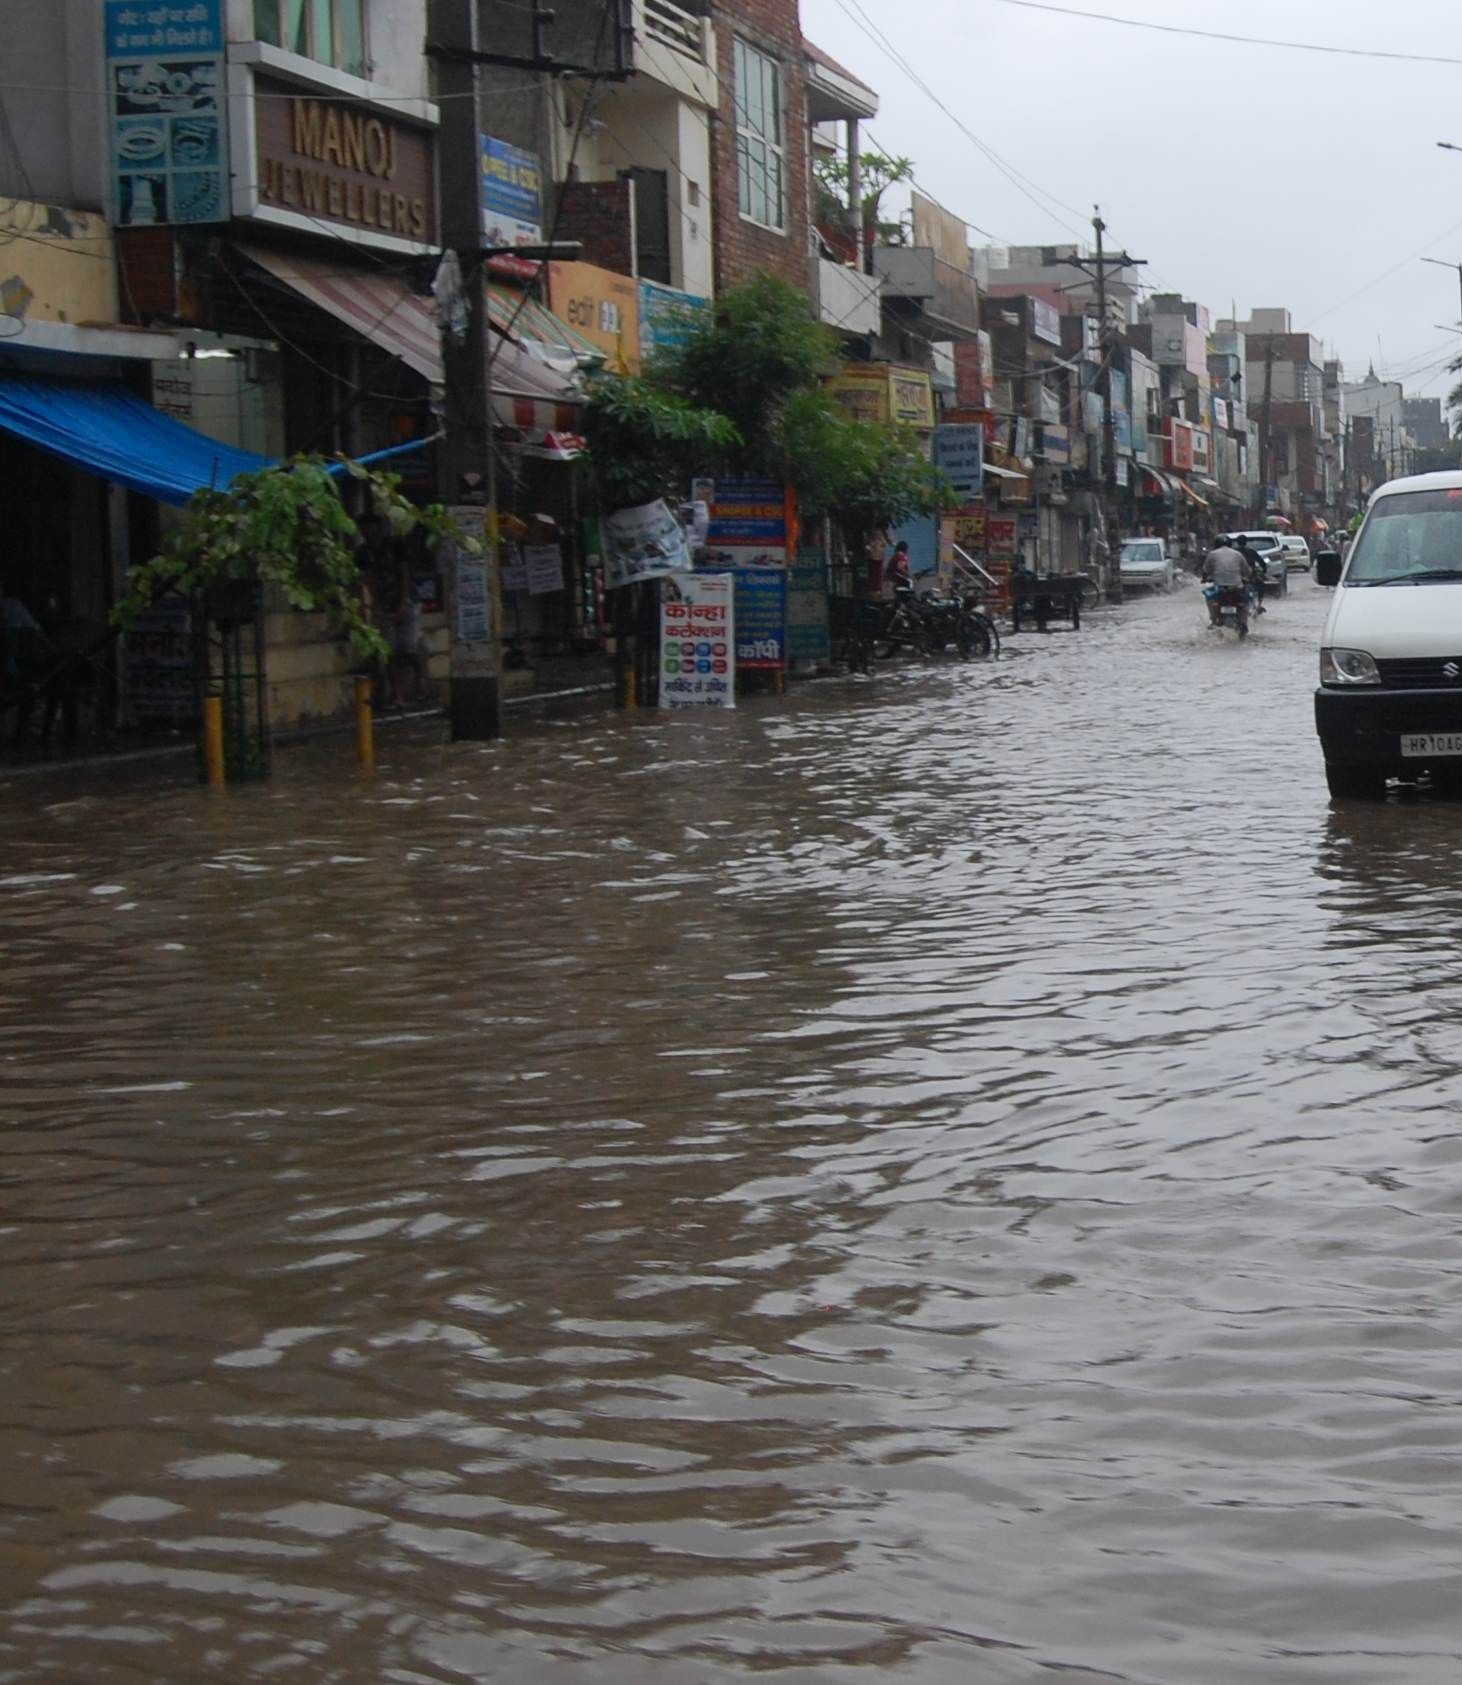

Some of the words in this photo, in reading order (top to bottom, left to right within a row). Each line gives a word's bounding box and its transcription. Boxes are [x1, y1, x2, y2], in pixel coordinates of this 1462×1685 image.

[294, 97, 396, 181] MANOJ
[263, 159, 426, 238] JEWELLERS
[664, 604, 727, 621] कान्हा
[737, 638, 781, 660] कॉपी
